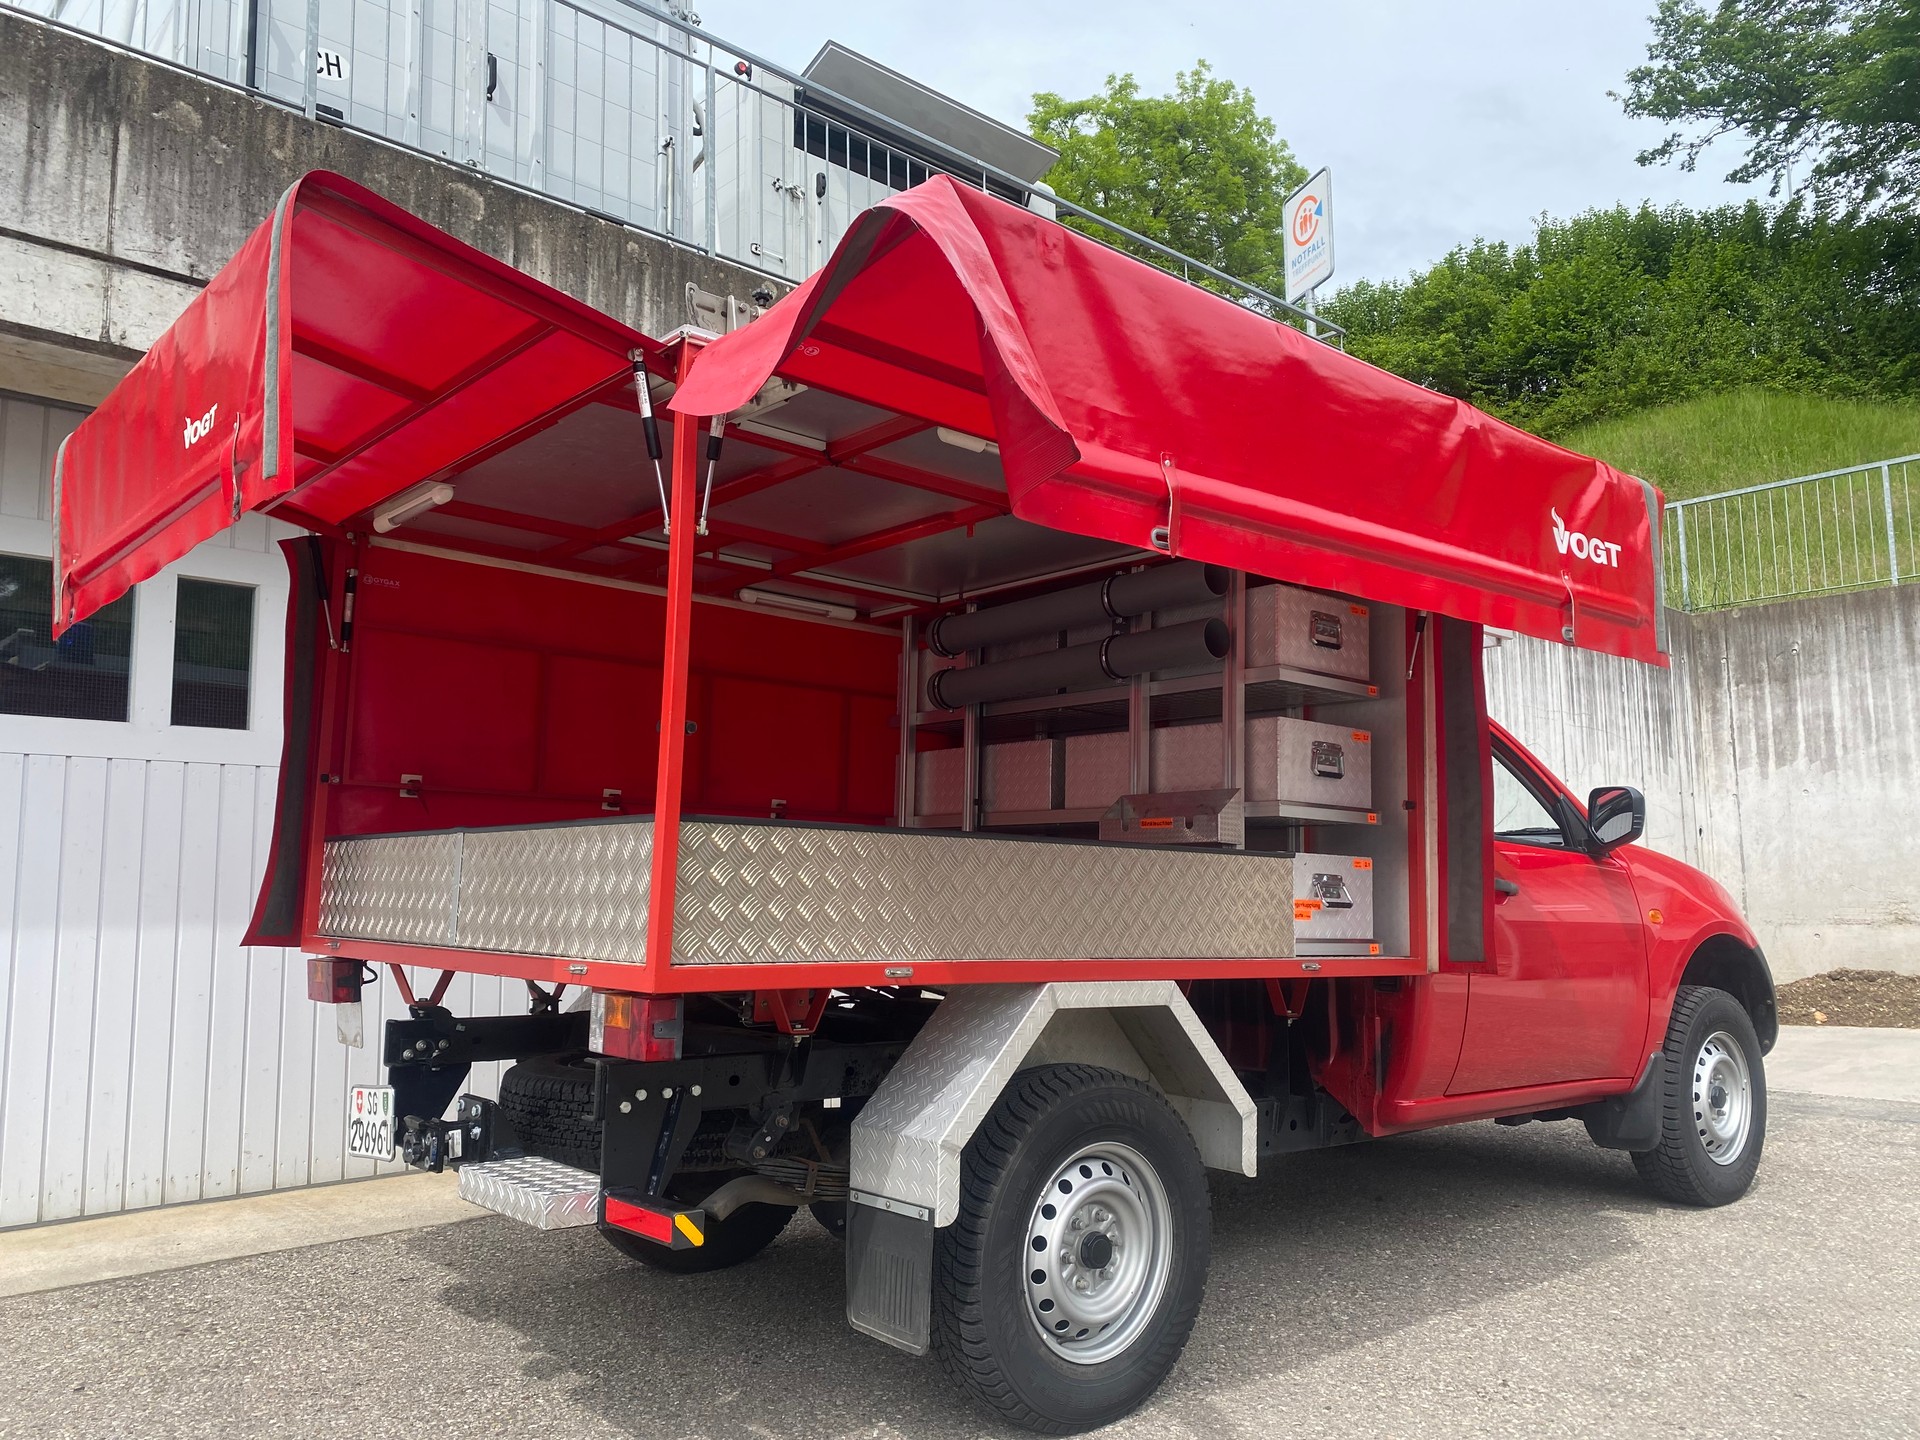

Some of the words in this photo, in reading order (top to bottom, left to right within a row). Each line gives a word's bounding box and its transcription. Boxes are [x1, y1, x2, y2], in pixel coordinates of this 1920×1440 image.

[1291, 236, 1326, 270] NOTFALL
[183, 402, 218, 450] VOGT
[1551, 507, 1622, 568] VOGT
[367, 1091, 378, 1116] SG
